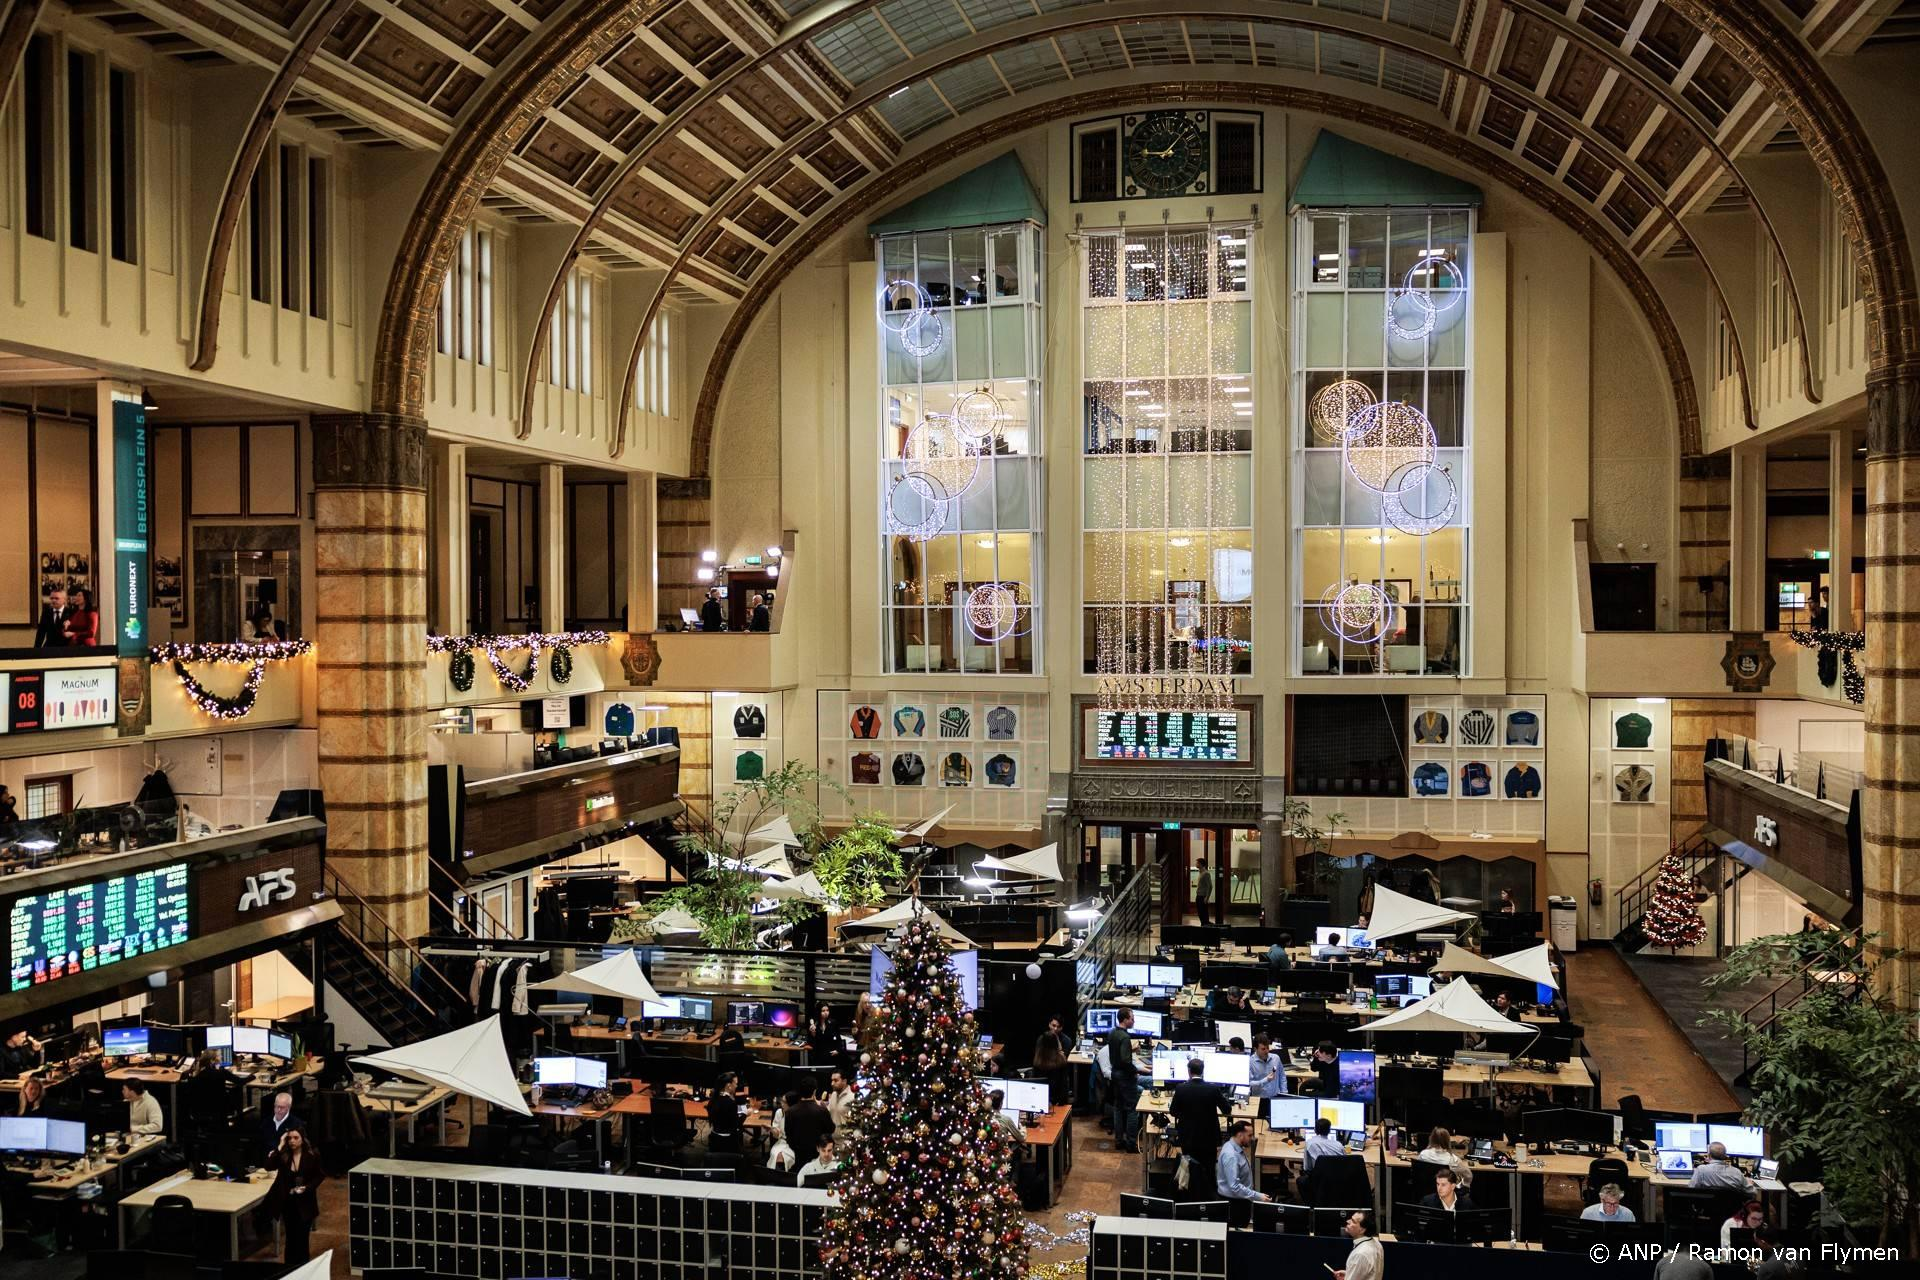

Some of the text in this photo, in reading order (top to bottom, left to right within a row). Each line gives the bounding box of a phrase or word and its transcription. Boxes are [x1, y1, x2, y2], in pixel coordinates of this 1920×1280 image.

[136, 415, 147, 534] BEURSPLEIN 5
[128, 561, 137, 615] EURONEXT
[61, 678, 99, 689] MAGNUM
[1099, 677, 1237, 694] AMSTERDAM
[18, 692, 36, 709] 08
